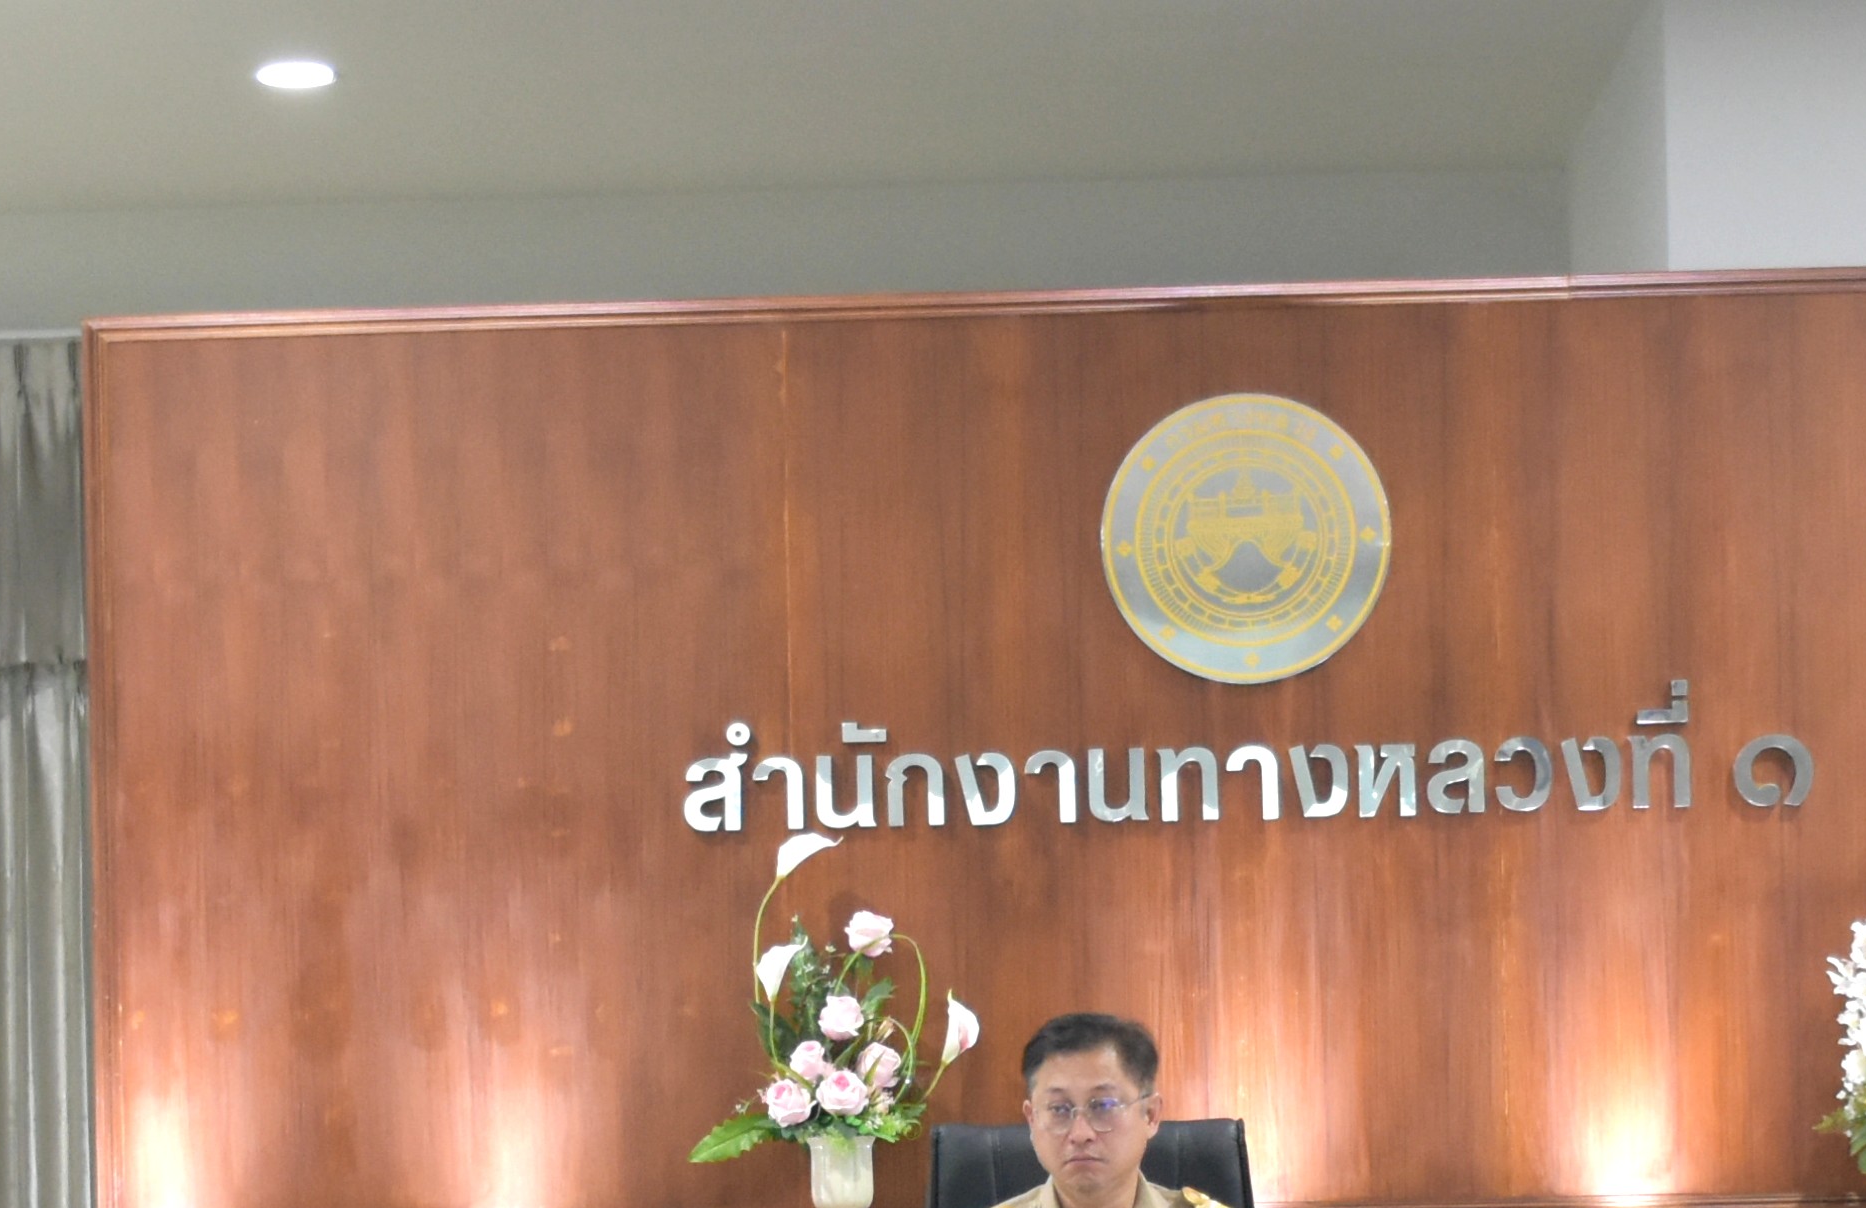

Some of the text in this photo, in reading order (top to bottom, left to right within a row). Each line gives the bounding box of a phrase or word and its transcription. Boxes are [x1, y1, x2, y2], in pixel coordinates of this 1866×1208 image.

[683, 679, 1815, 832] สำนักงานทางหลวงที่ ๑
